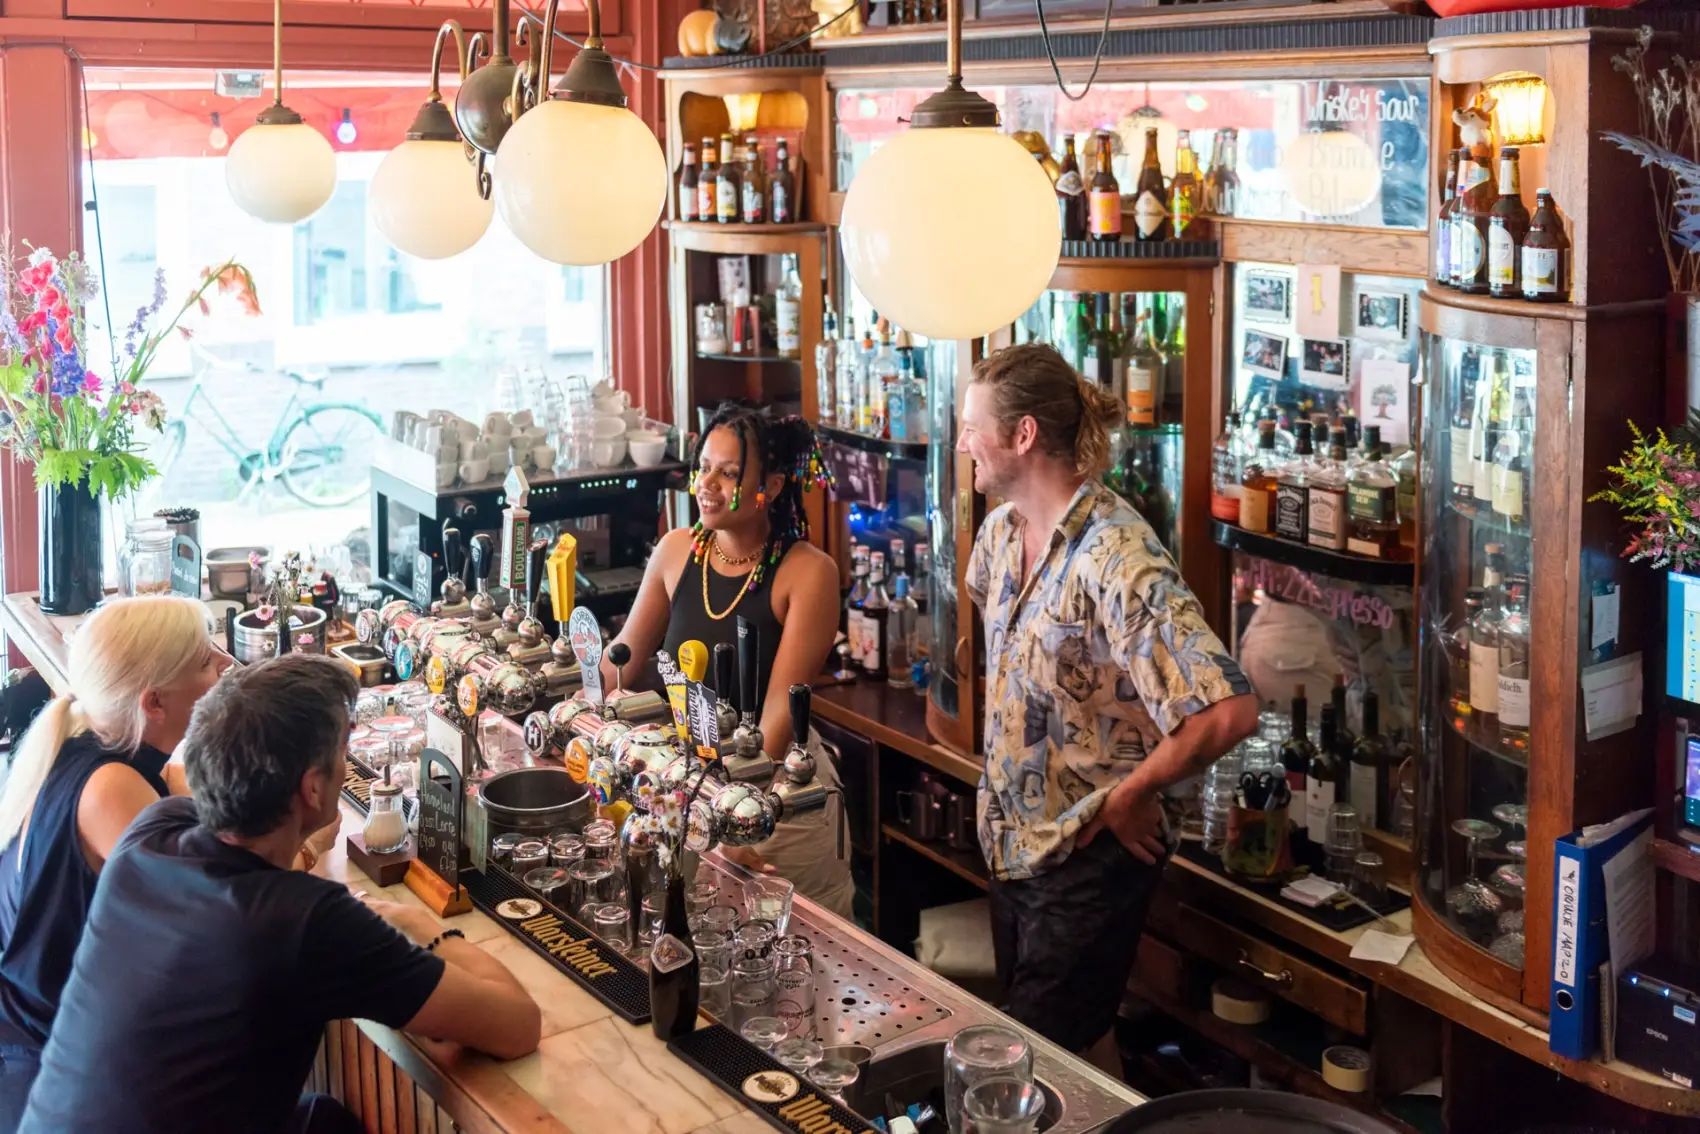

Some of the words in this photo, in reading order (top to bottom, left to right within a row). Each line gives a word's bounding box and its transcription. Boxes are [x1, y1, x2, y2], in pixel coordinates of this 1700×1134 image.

[1301, 80, 1370, 122] Whiskey
[1374, 87, 1420, 122] Sour
[513, 525, 526, 580] BOULEVARD
[420, 780, 456, 818] Homeland
[520, 913, 618, 978] Warsteiner
